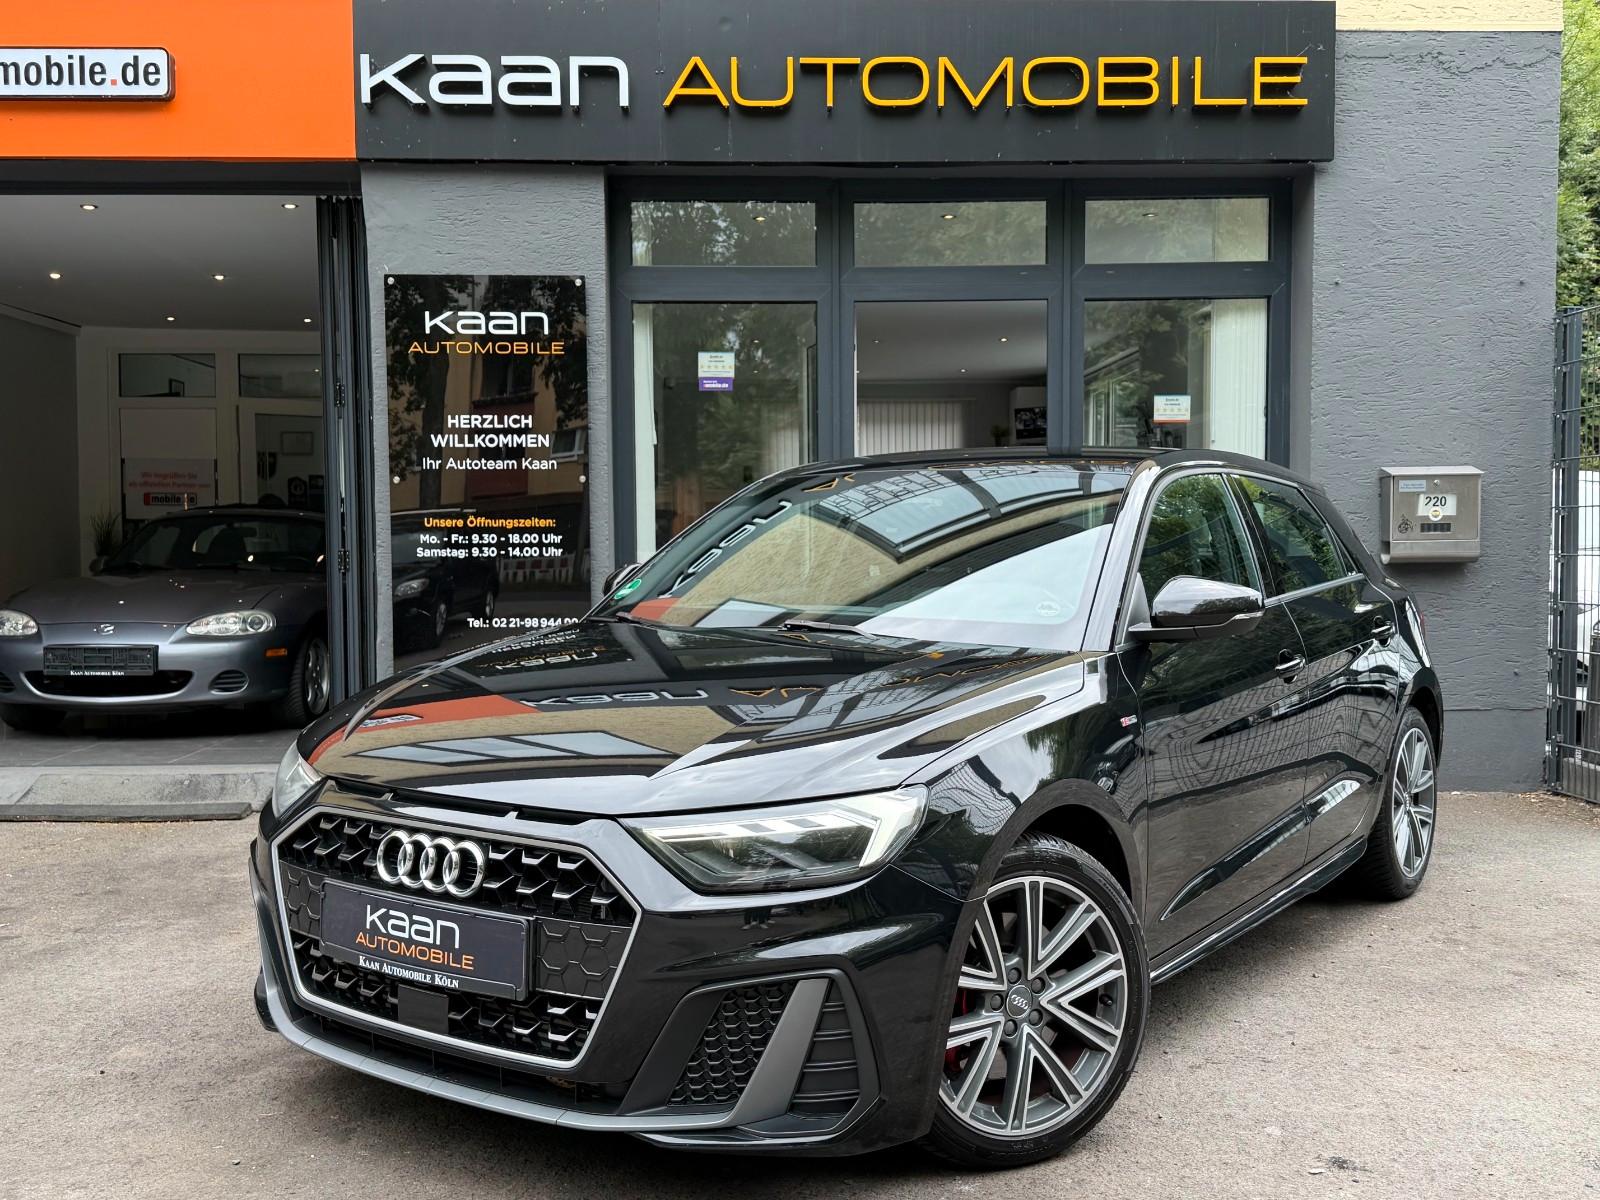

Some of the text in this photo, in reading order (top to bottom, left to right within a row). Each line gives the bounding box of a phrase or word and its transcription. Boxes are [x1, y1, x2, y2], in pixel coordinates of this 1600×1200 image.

[0, 54, 161, 87] mobile.de
[663, 56, 1309, 108] AUTOMOBILE
[408, 341, 565, 355] AUTOMOBILE
[447, 414, 533, 429] HERZLICH
[430, 433, 550, 448] WILLKOMMEN
[422, 457, 558, 470] Ihr Autoteam Kaan
[1424, 495, 1447, 507] 220
[424, 515, 556, 529] Unsere Öffnungszeiten:
[419, 533, 441, 544] Mo.
[451, 533, 469, 544] Fr.:
[471, 533, 498, 544] 9.30
[507, 533, 540, 544] 18.00
[541, 533, 563, 544] Uhr
[416, 547, 469, 559] Samstag:
[471, 547, 498, 558] 9.30
[507, 547, 540, 558] 14.00
[542, 547, 564, 558] Uhr
[466, 617, 490, 628] Tel.:
[354, 931, 475, 971] AUTOMOBILE
[359, 955, 460, 989] KAAN AUTOMOBILE KÖLN
